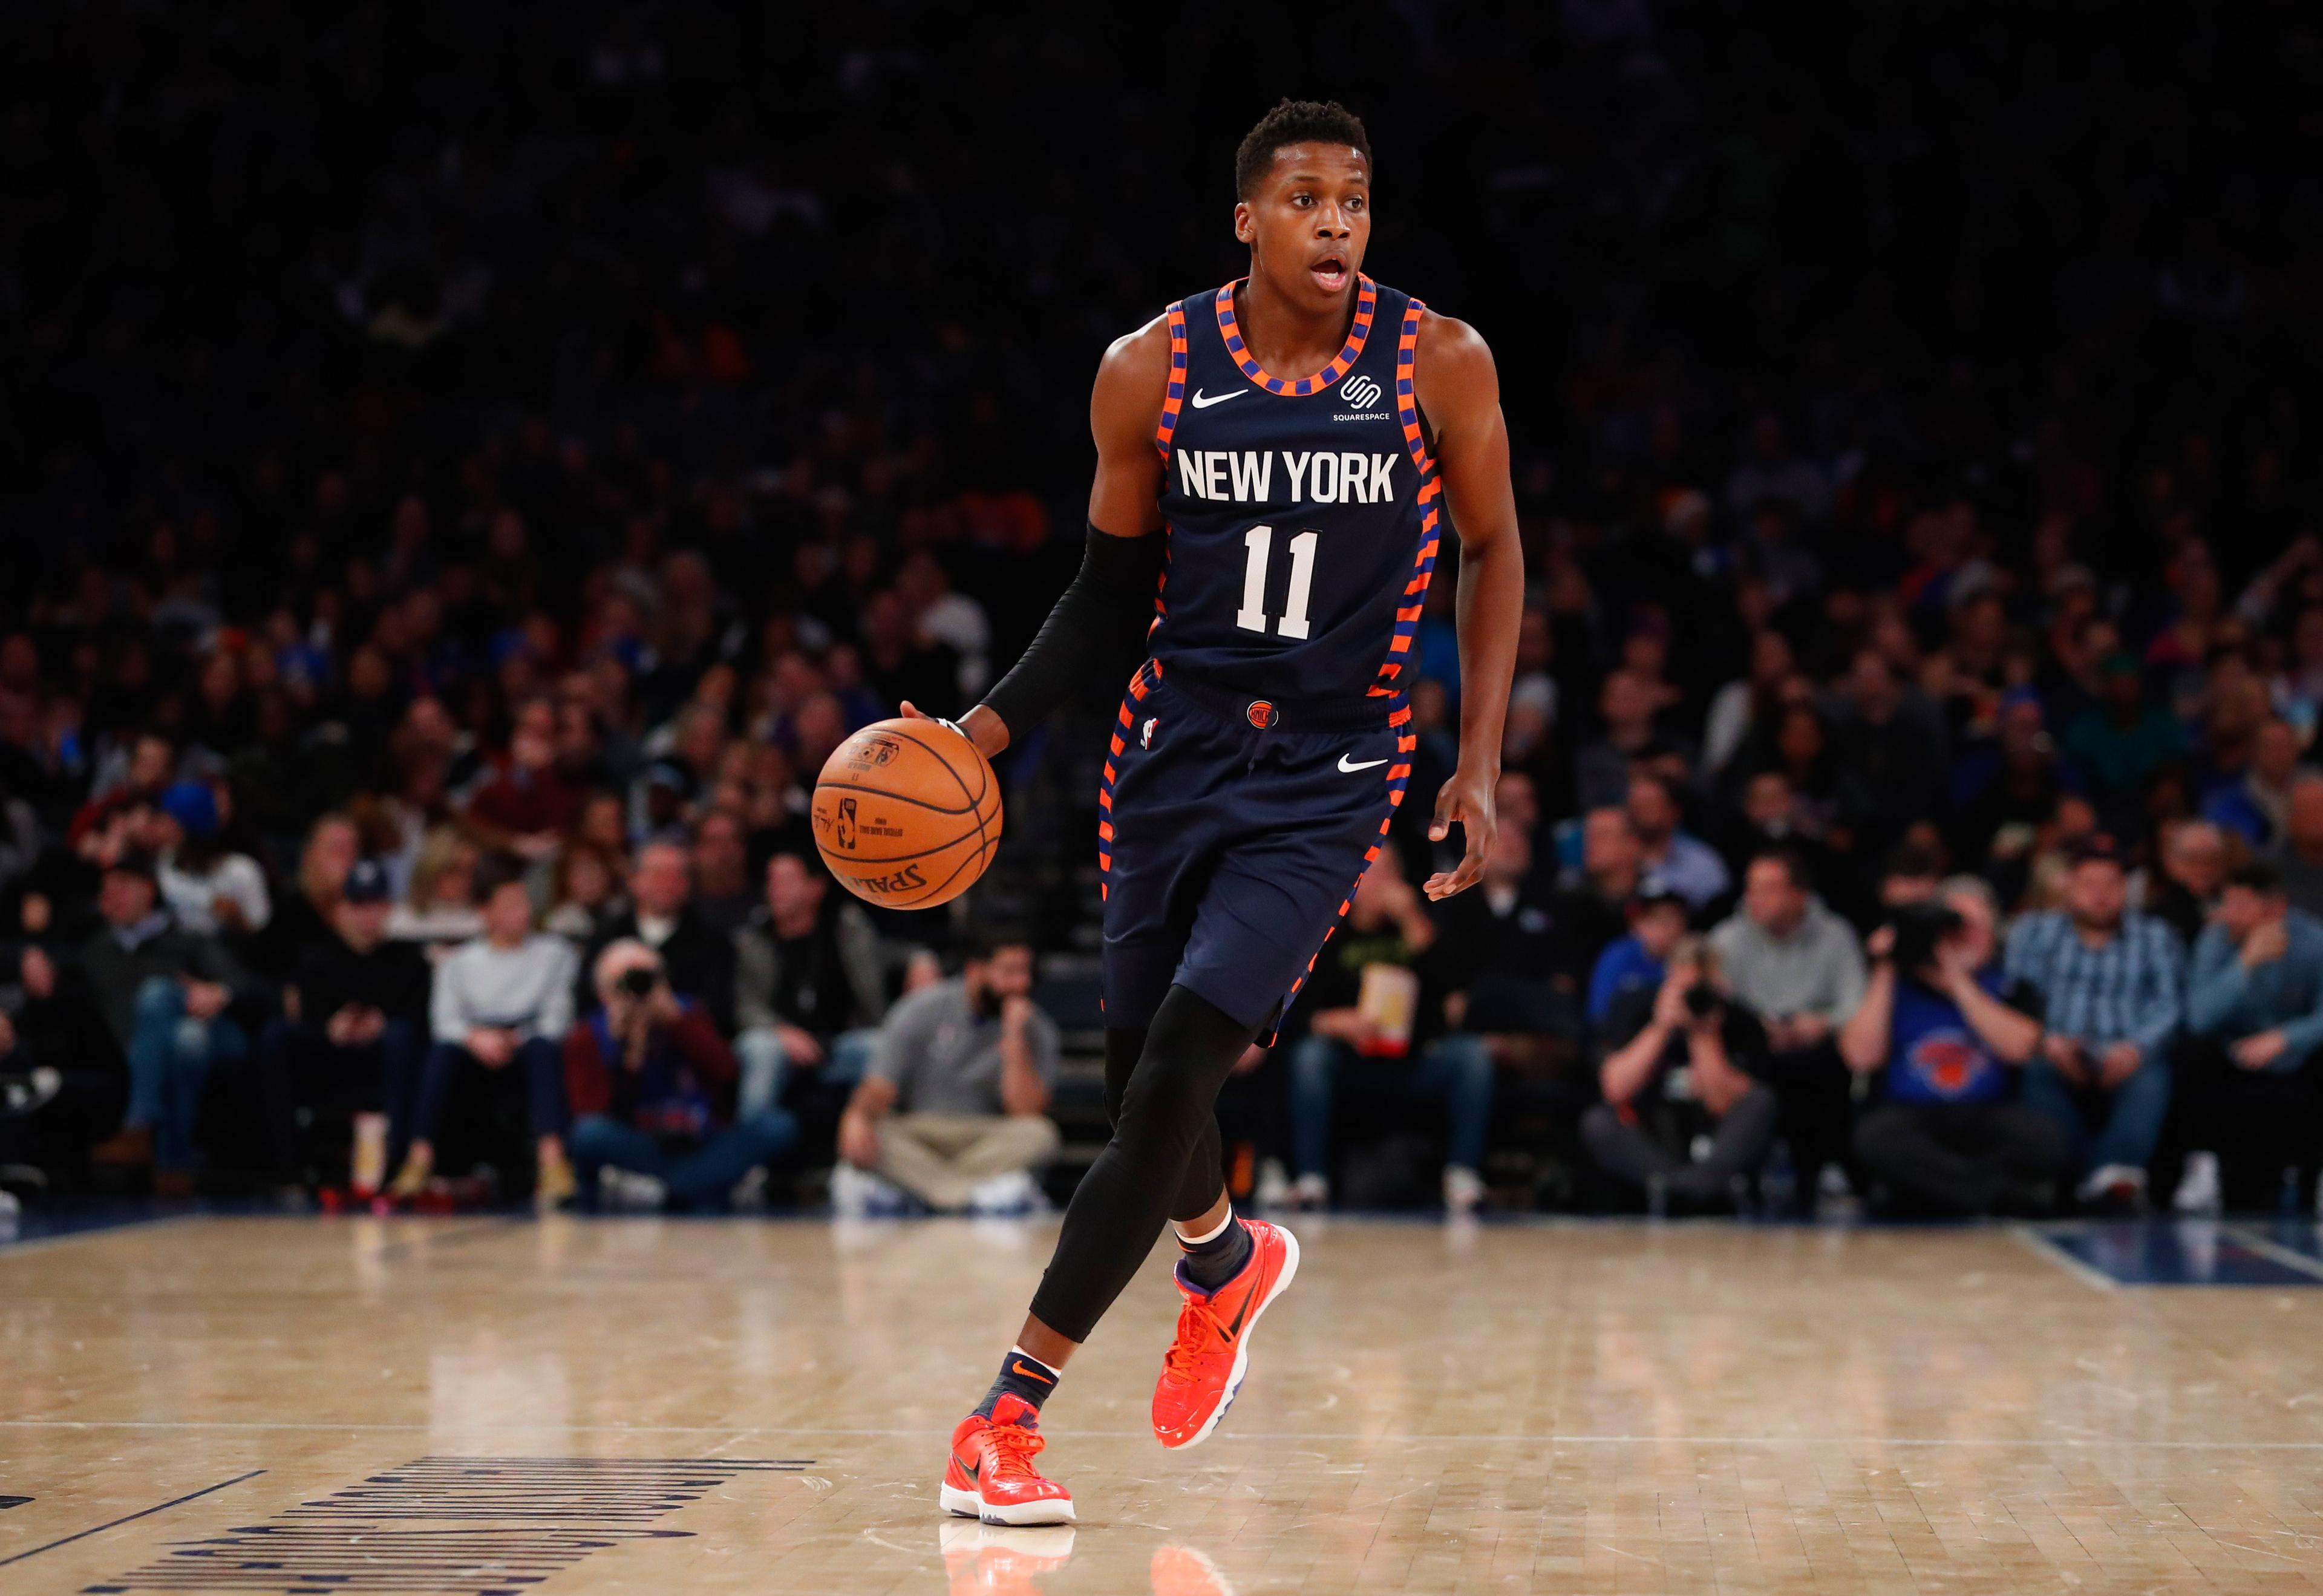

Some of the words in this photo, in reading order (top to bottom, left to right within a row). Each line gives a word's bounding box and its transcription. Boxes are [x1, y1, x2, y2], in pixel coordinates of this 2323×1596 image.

[1177, 449, 1272, 502] NEW
[1282, 451, 1399, 503] YORK
[1237, 526, 1318, 639] 11
[271, 1456, 816, 1522] MADISON
